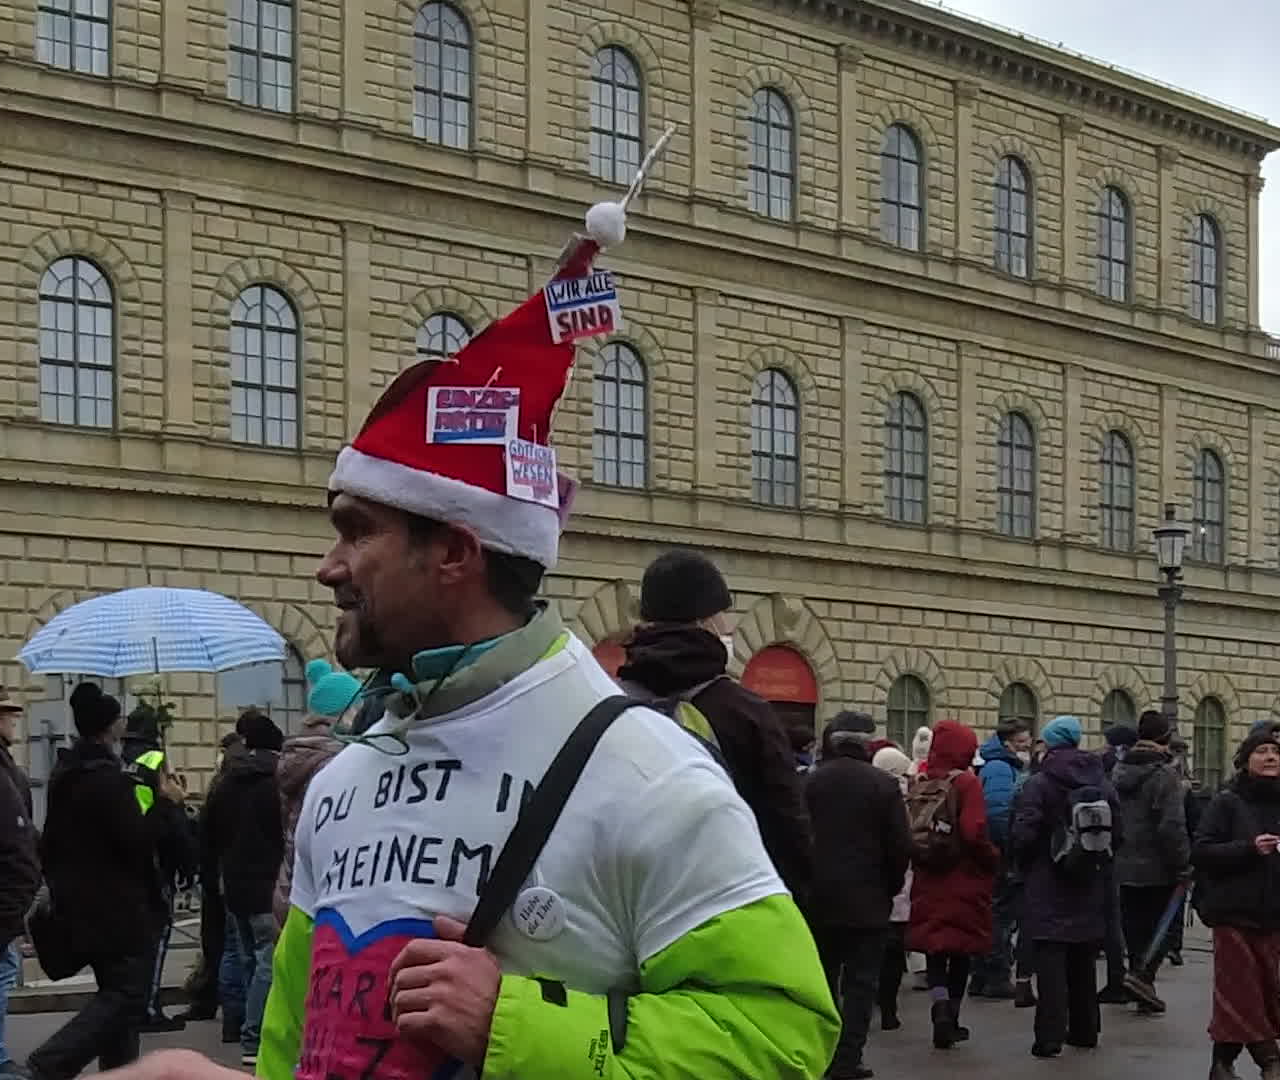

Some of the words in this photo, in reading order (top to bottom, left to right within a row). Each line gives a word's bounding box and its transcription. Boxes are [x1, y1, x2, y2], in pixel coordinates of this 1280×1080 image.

[546, 279, 582, 305] WIR
[556, 304, 615, 339] SIND
[315, 786, 358, 833] DU
[374, 759, 462, 808] BIST
[321, 834, 493, 897] MEINEM
[311, 966, 393, 1022] KAR
